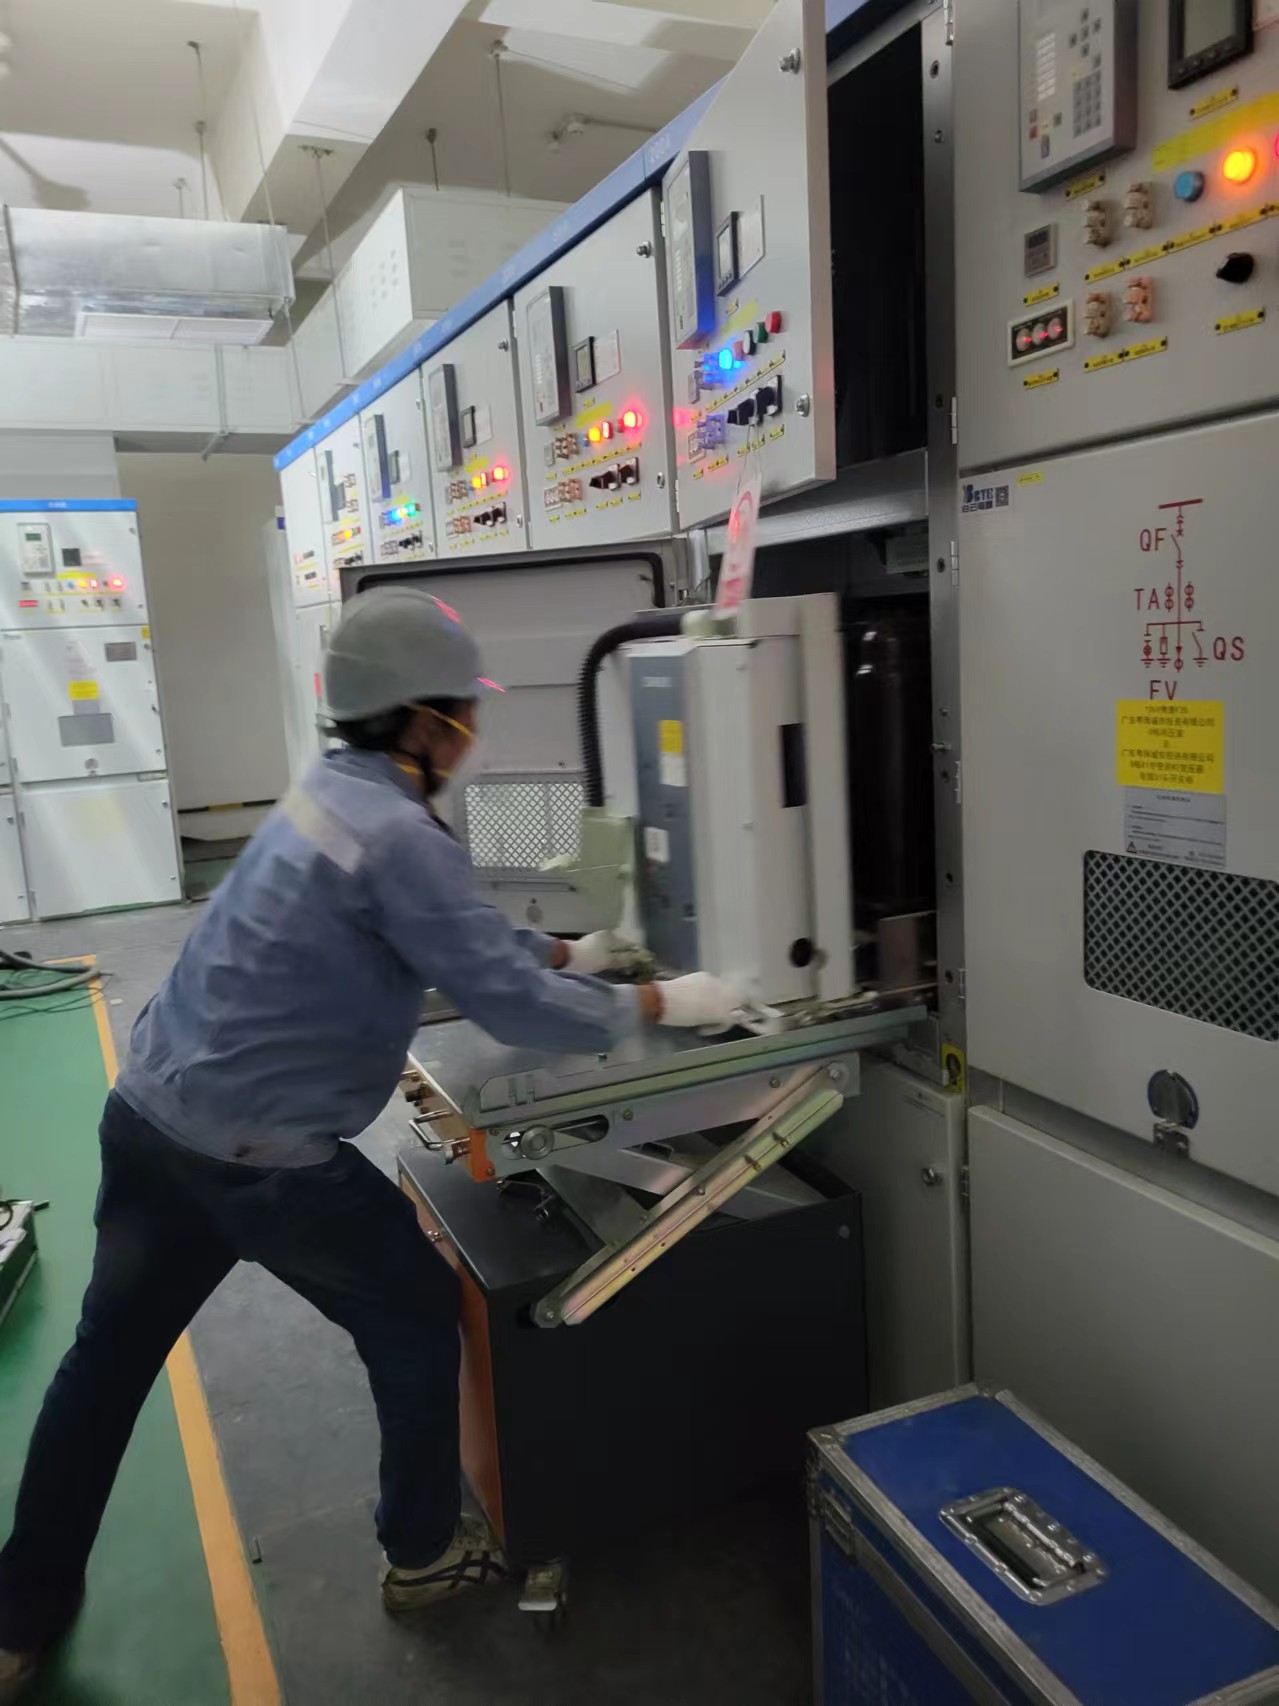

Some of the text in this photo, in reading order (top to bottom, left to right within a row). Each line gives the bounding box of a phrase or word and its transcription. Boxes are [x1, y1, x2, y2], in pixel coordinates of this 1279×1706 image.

[1139, 528, 1167, 552] QF
[1134, 588, 1160, 611] TA
[1213, 637, 1244, 662] QS
[1149, 680, 1178, 701] FV
